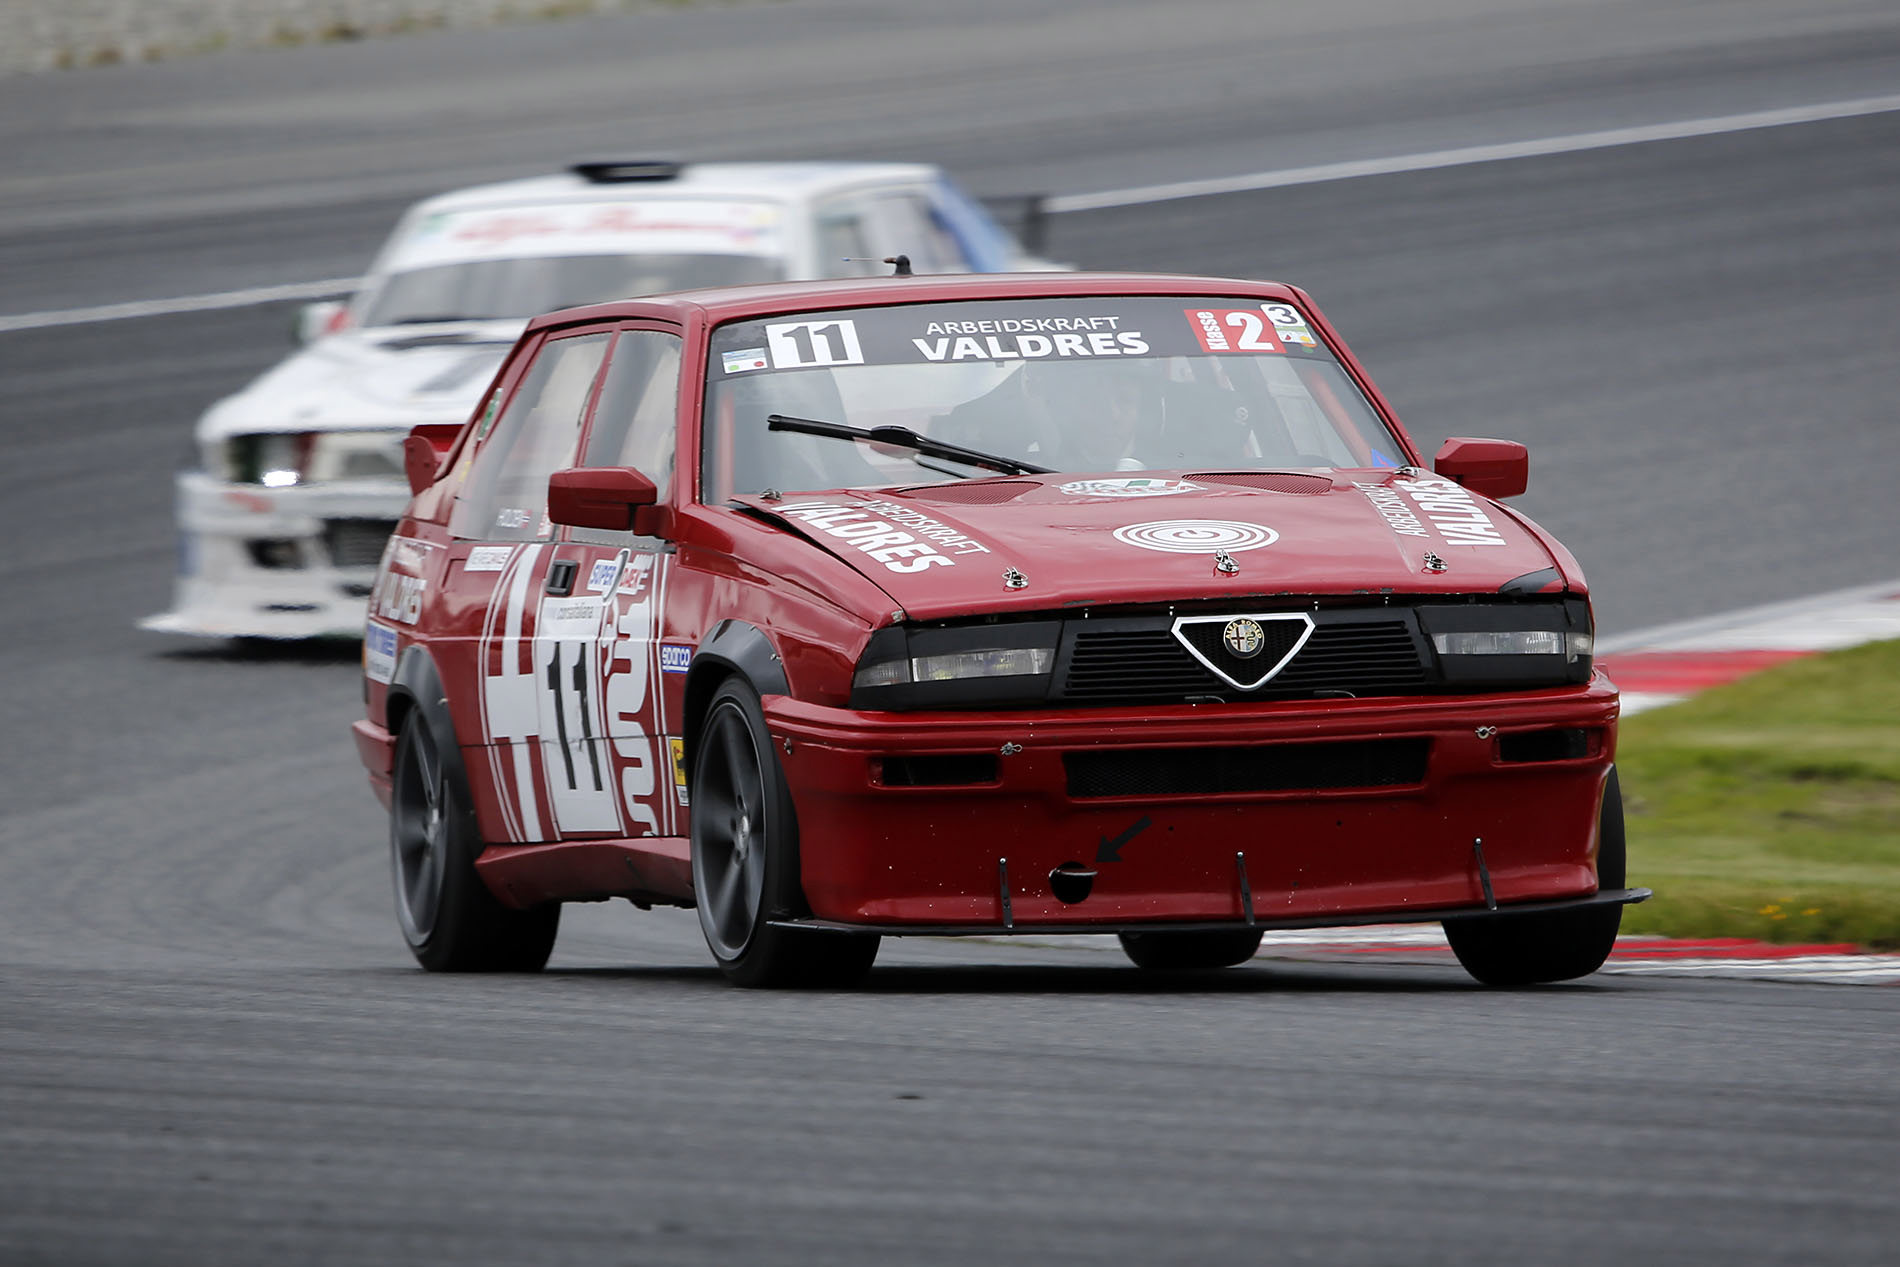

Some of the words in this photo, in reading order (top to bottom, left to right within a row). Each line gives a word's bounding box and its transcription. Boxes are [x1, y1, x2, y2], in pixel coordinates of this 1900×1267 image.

[926, 316, 1120, 336] ARBEIDSKRAFT
[1225, 311, 1275, 351] 2
[1268, 306, 1298, 324] 3
[782, 323, 849, 363] 11
[911, 331, 1151, 361] VALDRES
[1351, 481, 1431, 538] ARBEIDSKRAFT
[1393, 480, 1507, 545] VALDRES
[770, 501, 956, 574] VALDRES
[1225, 622, 1238, 640] ALFA
[1240, 619, 1263, 640] ROMEO
[547, 641, 603, 792] 11
